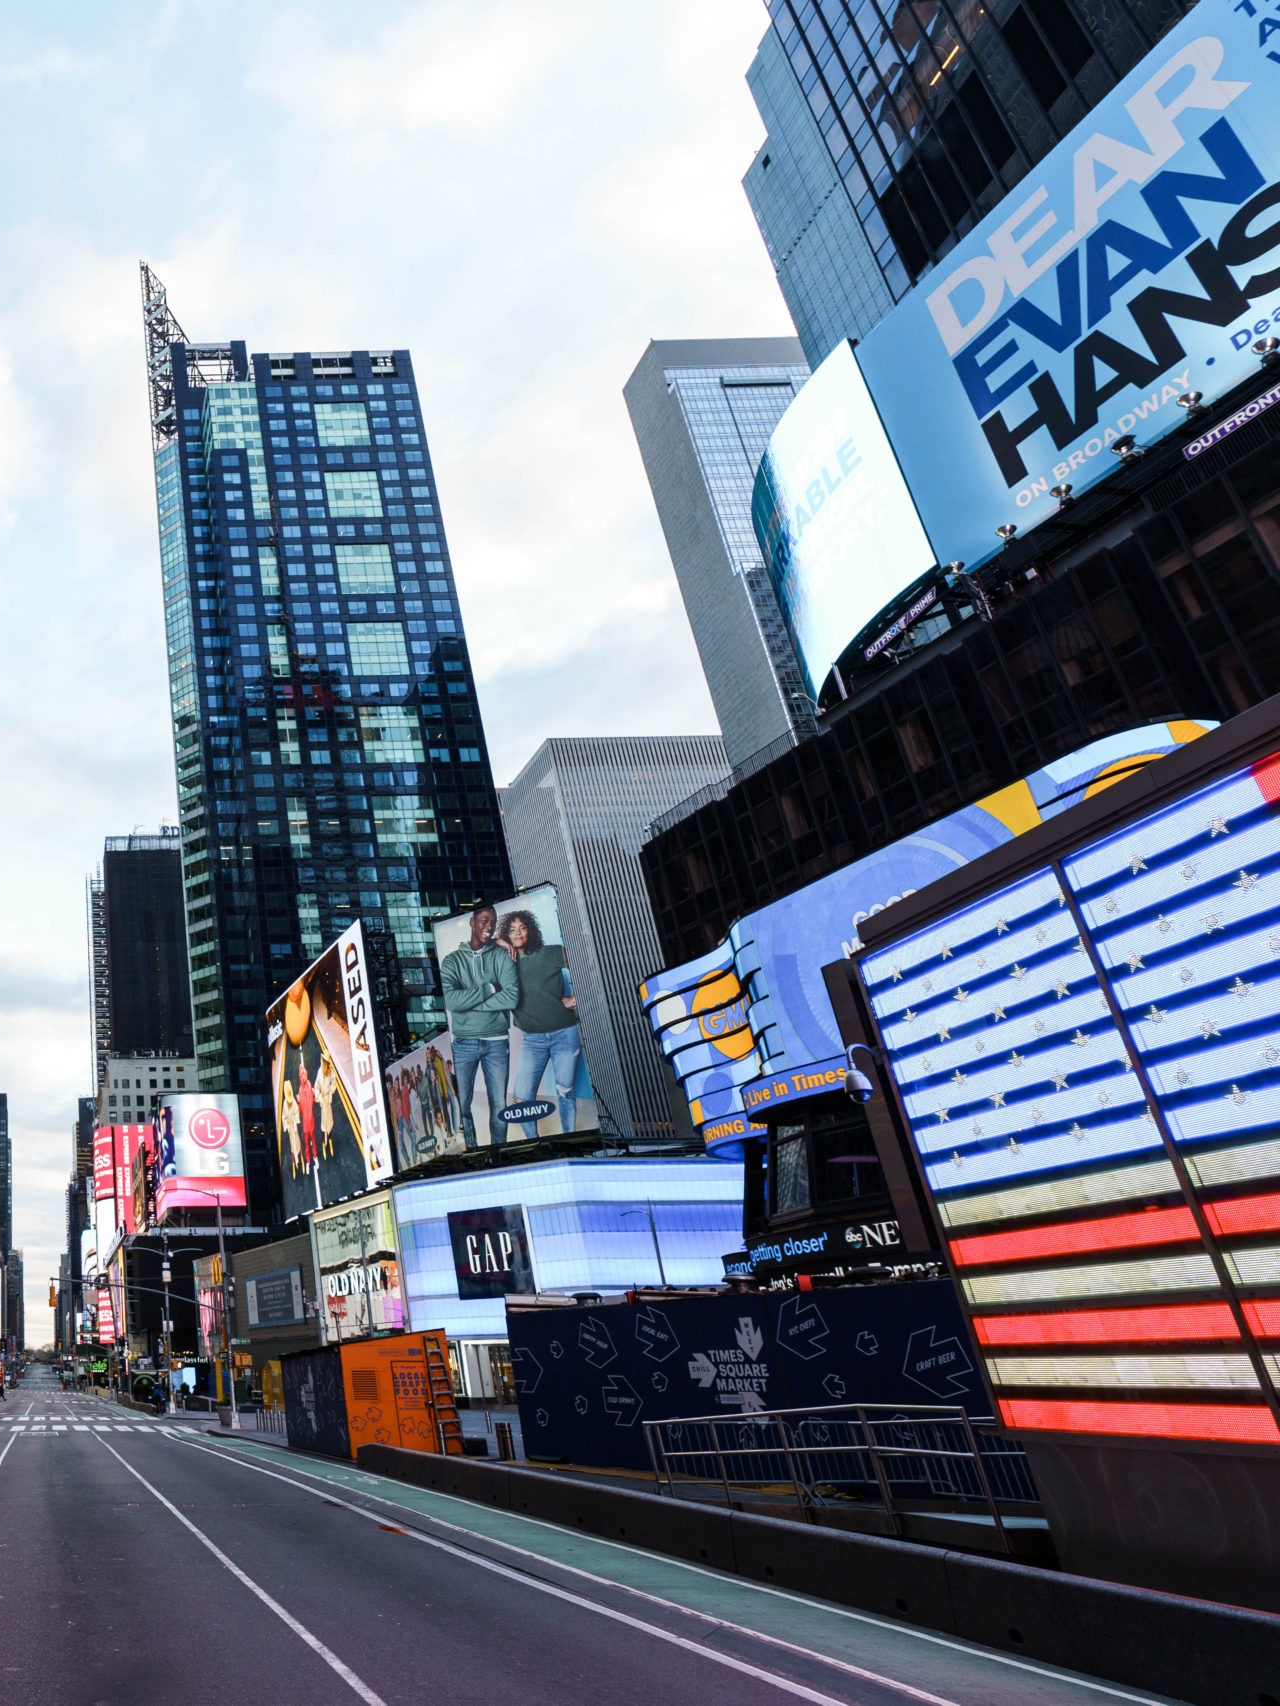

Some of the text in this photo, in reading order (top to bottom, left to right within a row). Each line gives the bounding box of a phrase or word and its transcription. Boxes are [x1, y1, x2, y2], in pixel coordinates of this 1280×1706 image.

[925, 35, 1253, 357] DEAR
[952, 116, 1267, 421] EVAN
[1188, 384, 1280, 455] OUTFRONT
[1014, 477, 1049, 508] ON
[1053, 368, 1192, 482] BROADWAY
[866, 592, 935, 658] OUTFRONT PRIME
[345, 941, 386, 1172] RELEASED
[748, 1067, 847, 1107] Live in Times
[504, 1104, 549, 1120] OLD NAVY
[418, 1137, 436, 1150] OLD NAVY
[194, 1151, 231, 1175] LG
[862, 1220, 900, 1248] NE
[466, 1231, 512, 1274] GAP
[749, 1244, 783, 1266] getting
[328, 1266, 382, 1297] OLD NAVY
[789, 1318, 816, 1336] NYC CHEFS
[708, 1349, 745, 1363] TIMES
[916, 1351, 956, 1372] CRAFT BEER
[394, 1372, 427, 1380] LOCAL
[719, 1363, 770, 1377] SQUARE
[394, 1380, 427, 1388] CRAFT
[395, 1388, 428, 1396] FOOD
[716, 1378, 767, 1392] MARKET
